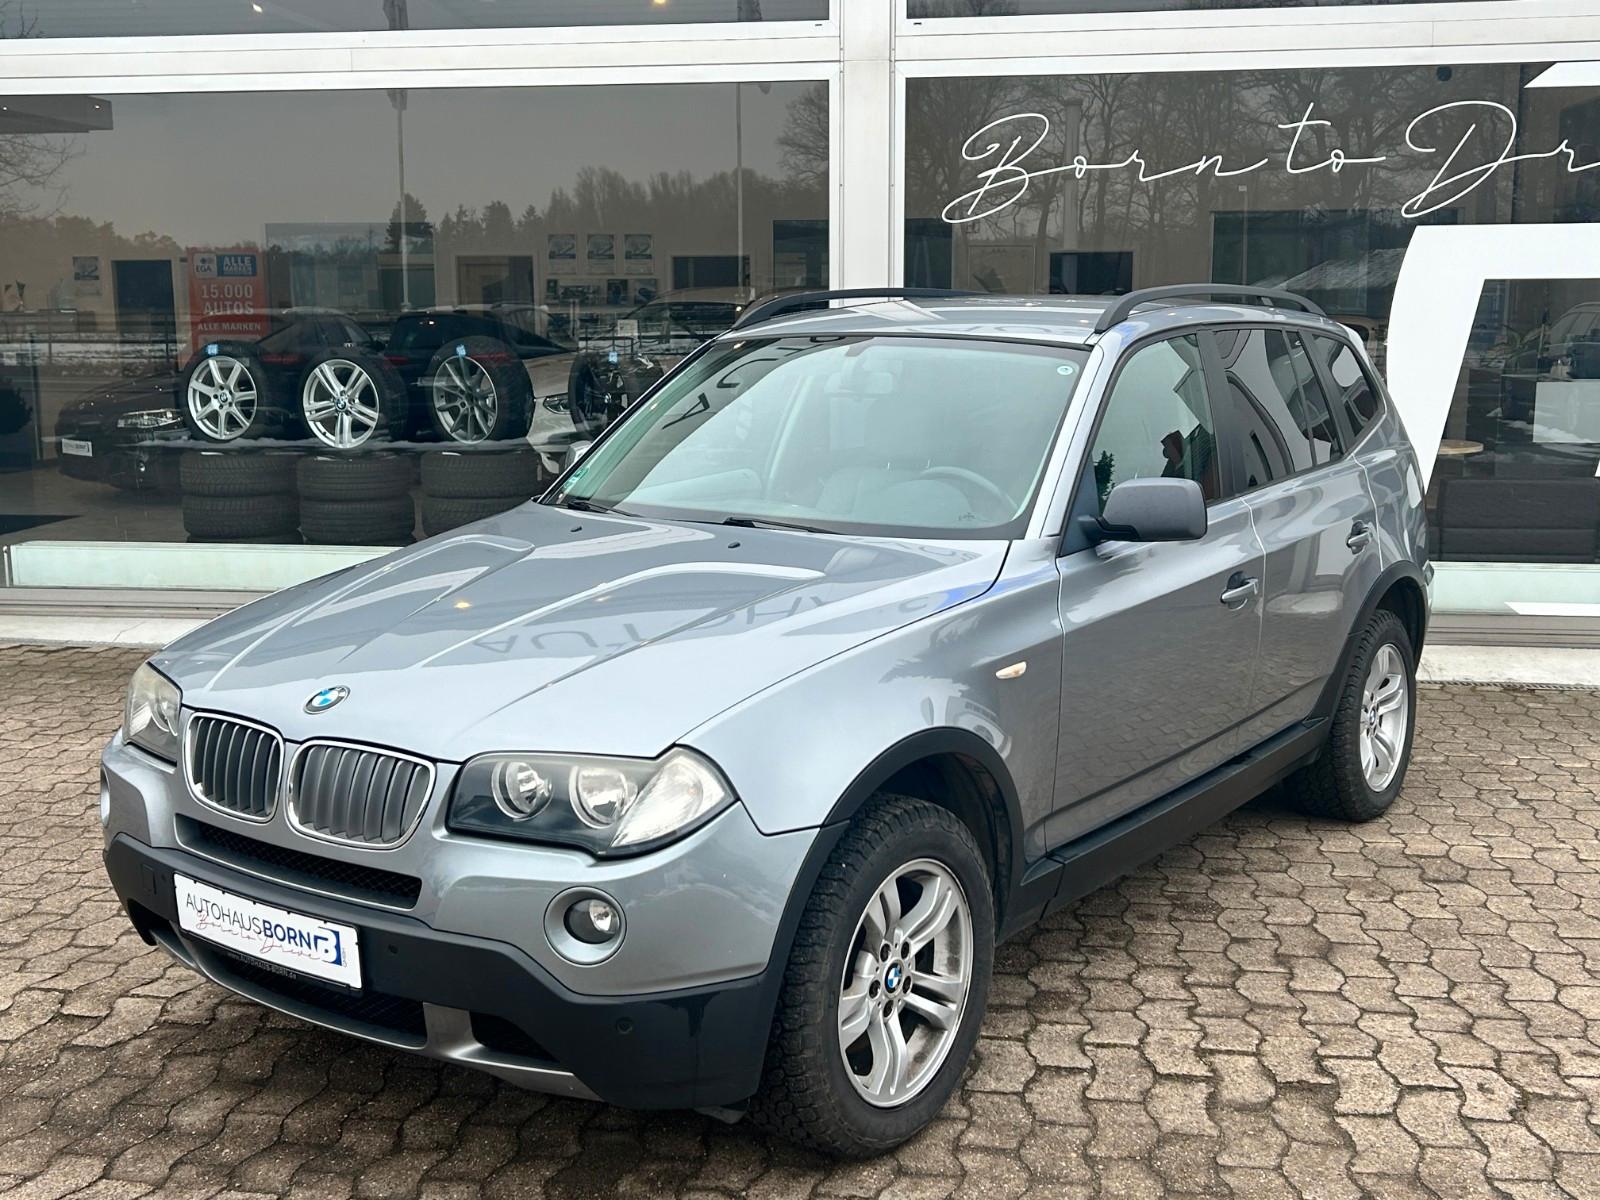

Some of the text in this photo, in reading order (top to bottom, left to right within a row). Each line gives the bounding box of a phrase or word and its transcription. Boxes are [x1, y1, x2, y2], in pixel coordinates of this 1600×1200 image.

[941, 113, 1268, 223] Born
[1278, 102, 1386, 173] to
[223, 256, 252, 265] ALLE
[201, 284, 253, 298] 15.000
[204, 301, 254, 315] AUTOS
[198, 323, 261, 331] ALLE MARKEN
